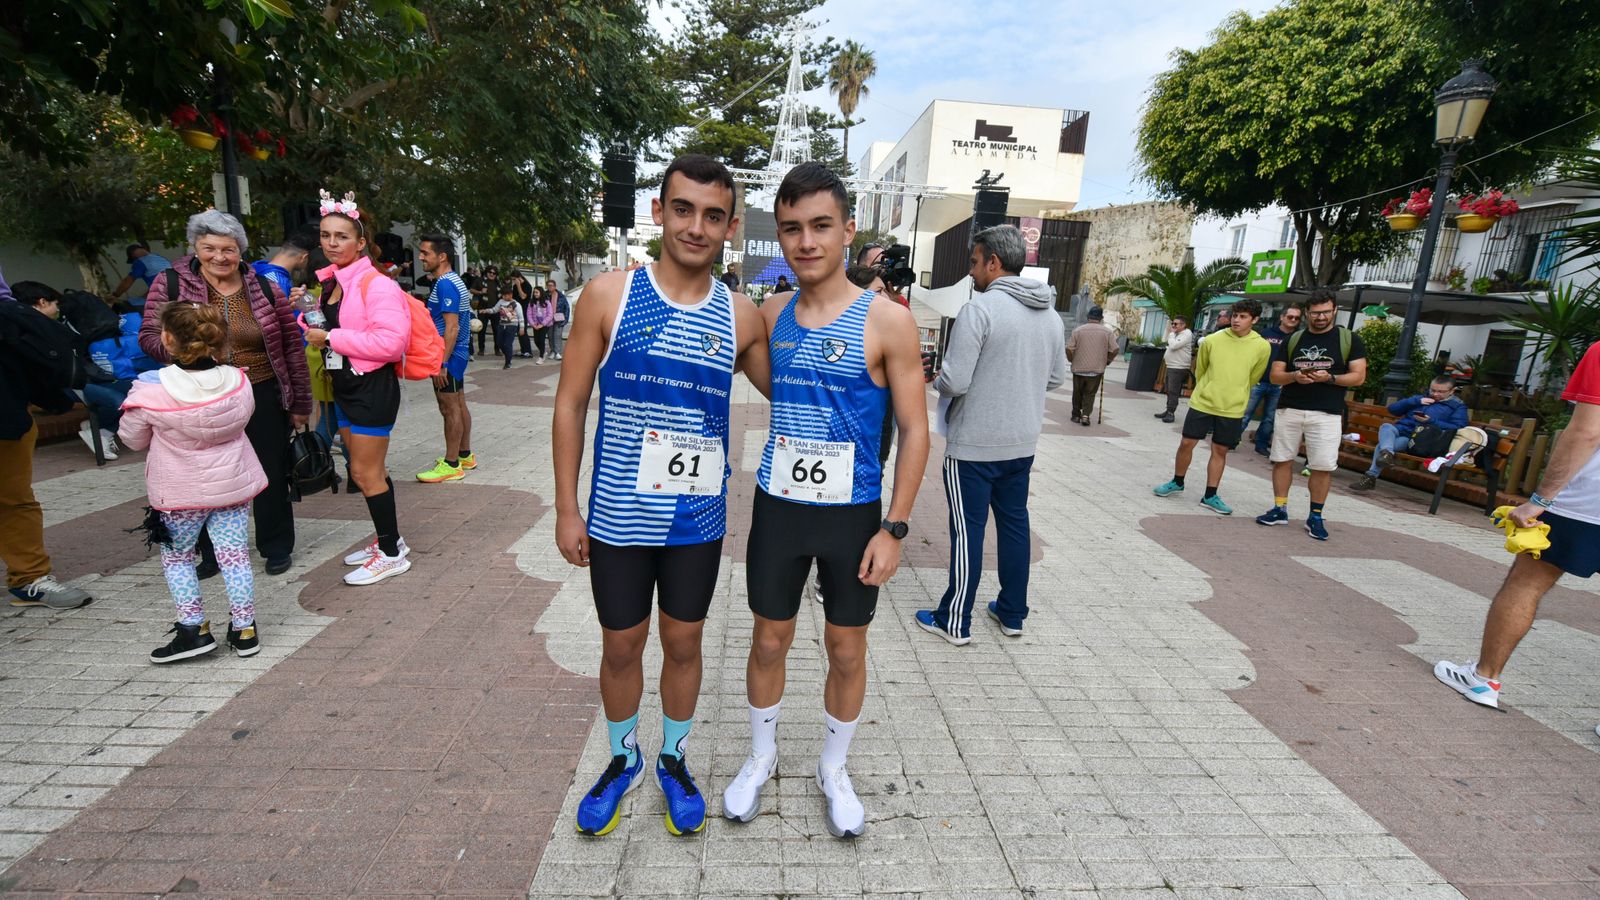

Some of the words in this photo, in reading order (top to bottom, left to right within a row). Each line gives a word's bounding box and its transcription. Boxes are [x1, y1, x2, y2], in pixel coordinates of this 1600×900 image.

[952, 139, 986, 149] TEATRO
[990, 142, 1037, 153] MUNICIPAL
[952, 148, 1036, 160] ALAMEDA
[747, 239, 785, 258] CARR
[615, 371, 636, 380] CLUB
[640, 374, 693, 389] ATLETISMO
[781, 374, 816, 387] Atletismo
[670, 434, 687, 442] SAN
[688, 436, 721, 446] SILVESTR
[672, 442, 702, 451] TARIFEÑA
[793, 440, 808, 448] SAN
[809, 442, 850, 451] SILVESTRE
[795, 447, 824, 457] TARIFEÑA
[668, 452, 700, 477] 61
[792, 458, 827, 484] 66
